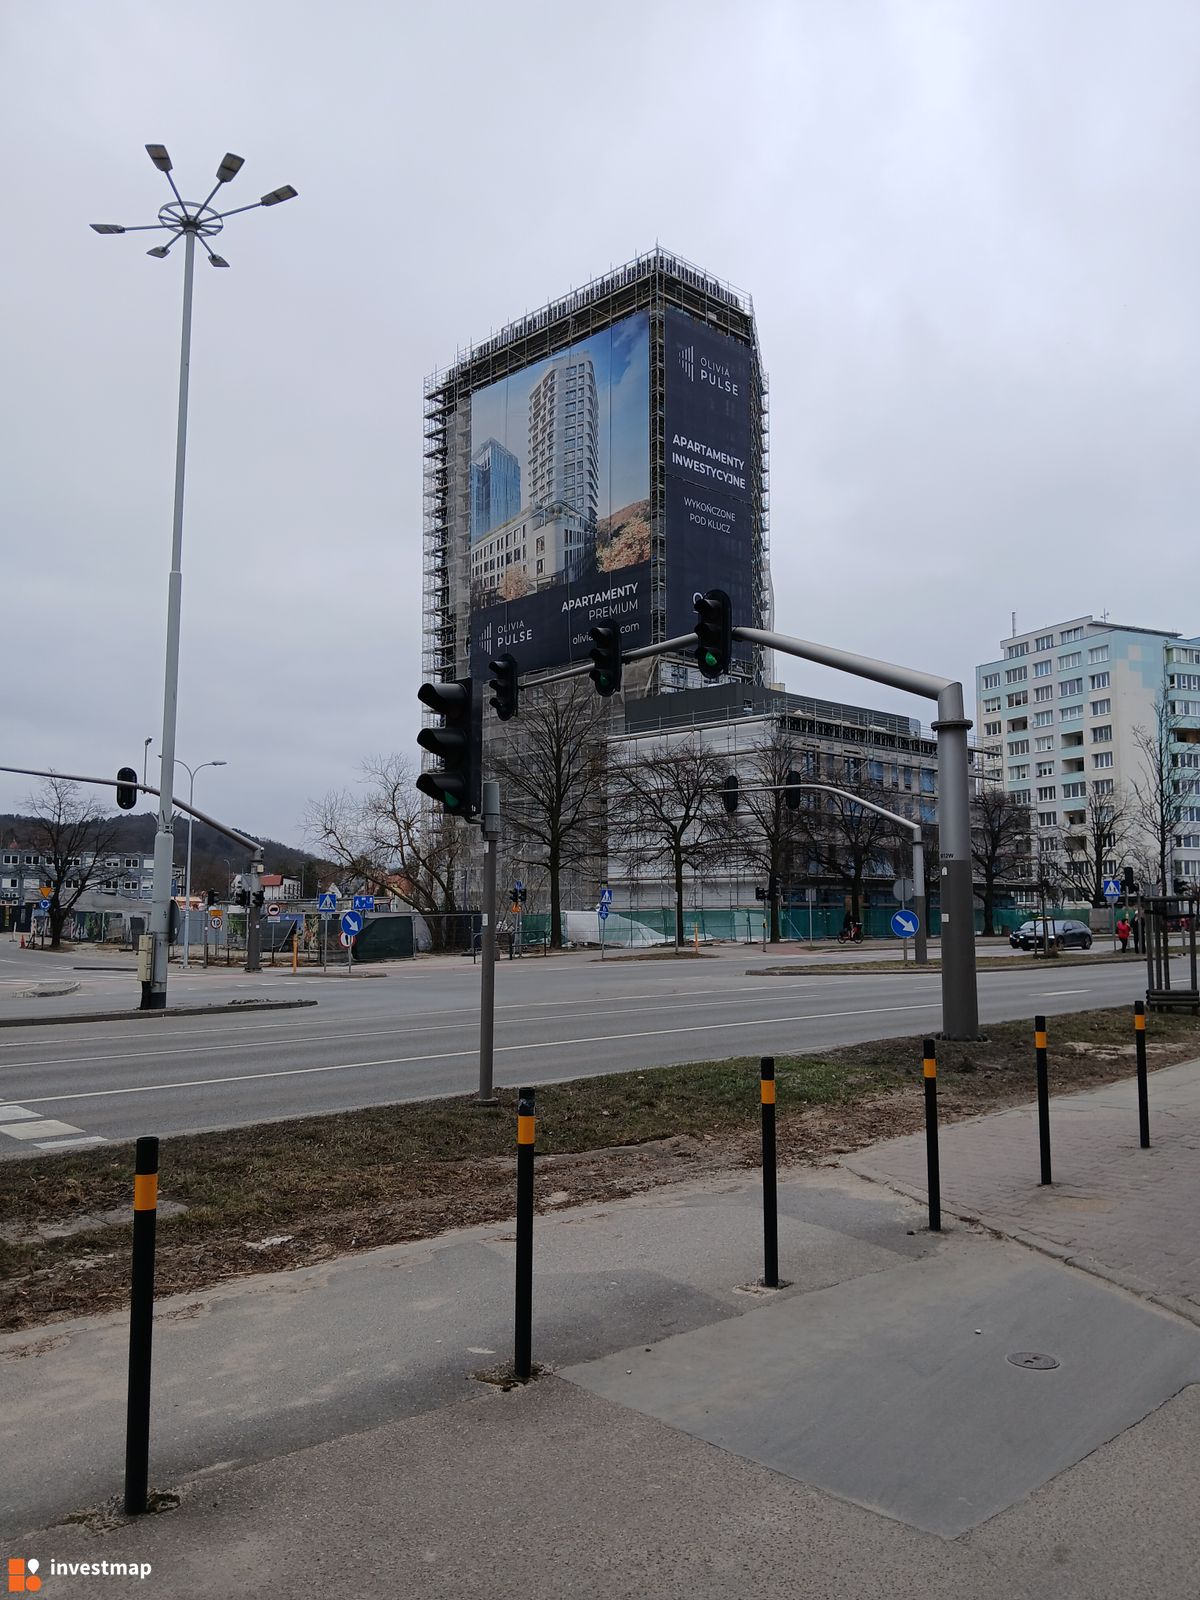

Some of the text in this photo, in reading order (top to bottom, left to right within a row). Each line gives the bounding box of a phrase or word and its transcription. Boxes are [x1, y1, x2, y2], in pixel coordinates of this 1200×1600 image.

[700, 357, 730, 378] OLIVIA
[700, 369, 739, 396] PULSE
[672, 433, 745, 470] APARTAMENTY
[672, 452, 746, 490] INWESTYCYJNE
[683, 496, 736, 522] WYKOŃCZONE
[689, 512, 731, 534] POD KLUCZ
[561, 582, 639, 613] APARTAMENTY
[588, 598, 638, 621] PREMIUM
[497, 620, 525, 634] OLIVIA
[497, 629, 533, 648] PULSE
